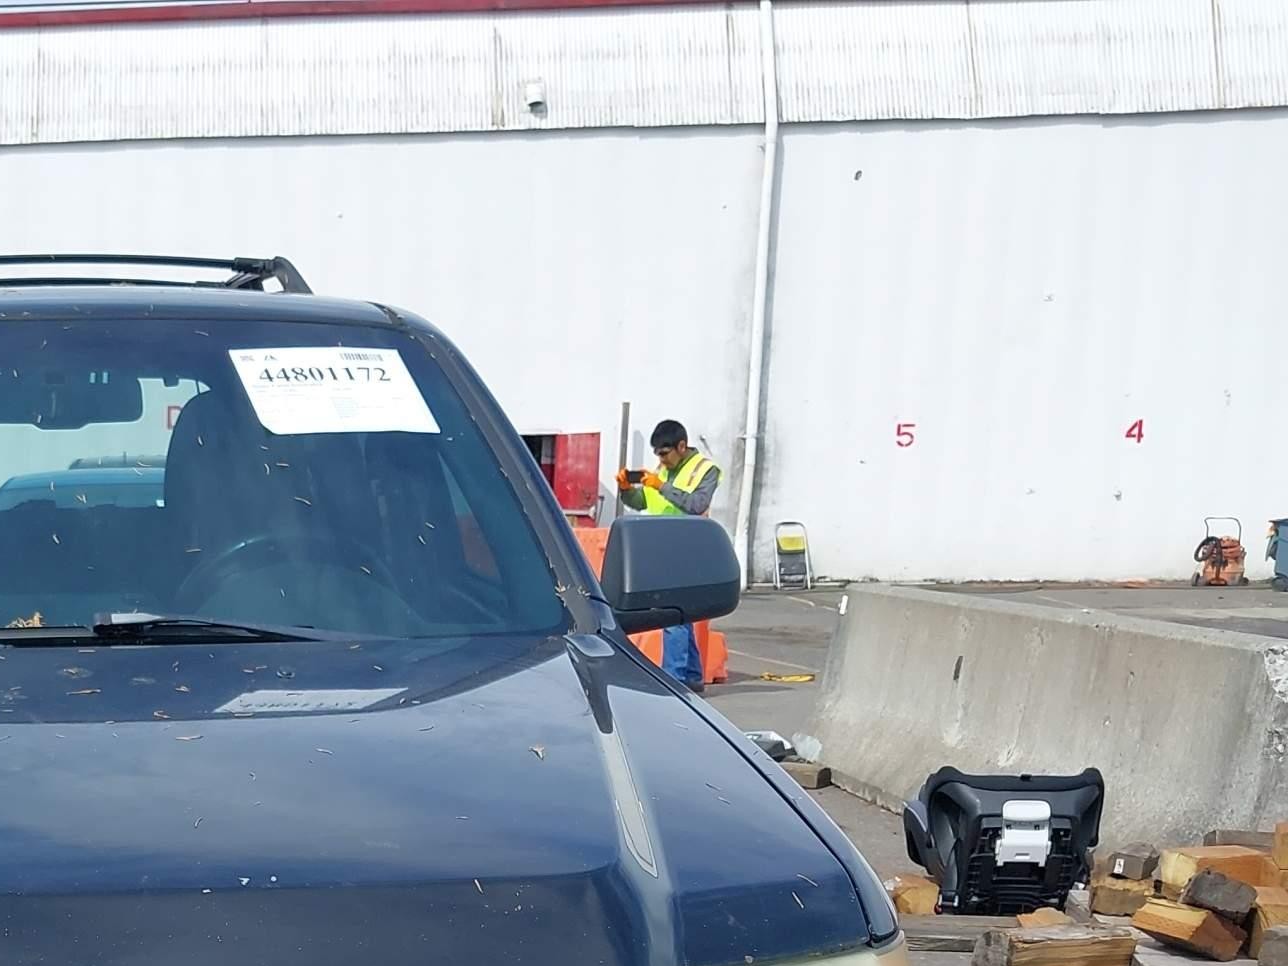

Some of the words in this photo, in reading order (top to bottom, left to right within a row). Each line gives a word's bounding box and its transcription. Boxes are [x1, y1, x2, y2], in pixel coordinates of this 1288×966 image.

[259, 366, 391, 382] 44801172
[896, 423, 916, 447] 5
[1125, 419, 1144, 443] 4
